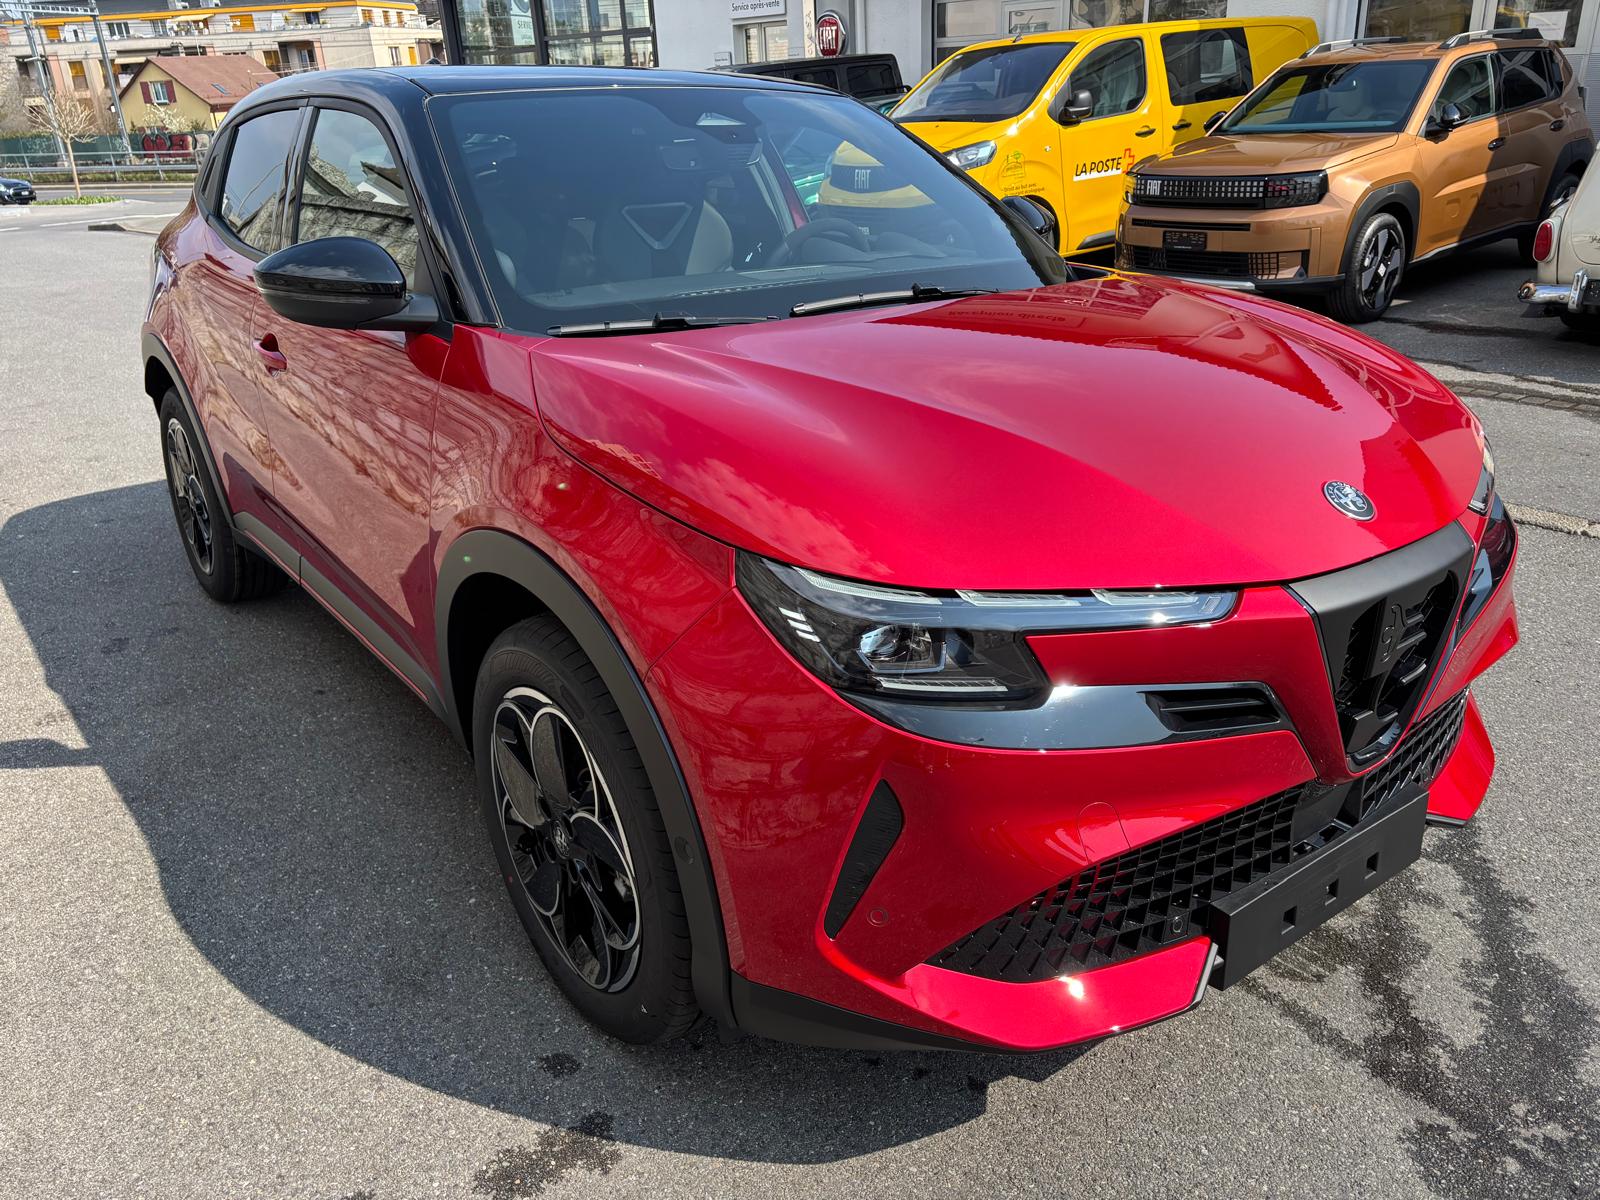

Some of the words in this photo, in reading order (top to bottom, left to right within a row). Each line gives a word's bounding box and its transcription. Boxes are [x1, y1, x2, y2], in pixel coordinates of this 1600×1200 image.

[731, 2, 749, 12] Service
[819, 26, 838, 50] FIAT
[1075, 162, 1087, 177] LA
[1089, 156, 1123, 175] POSTE
[855, 169, 871, 190] FIAT
[1146, 179, 1162, 196] FIAT
